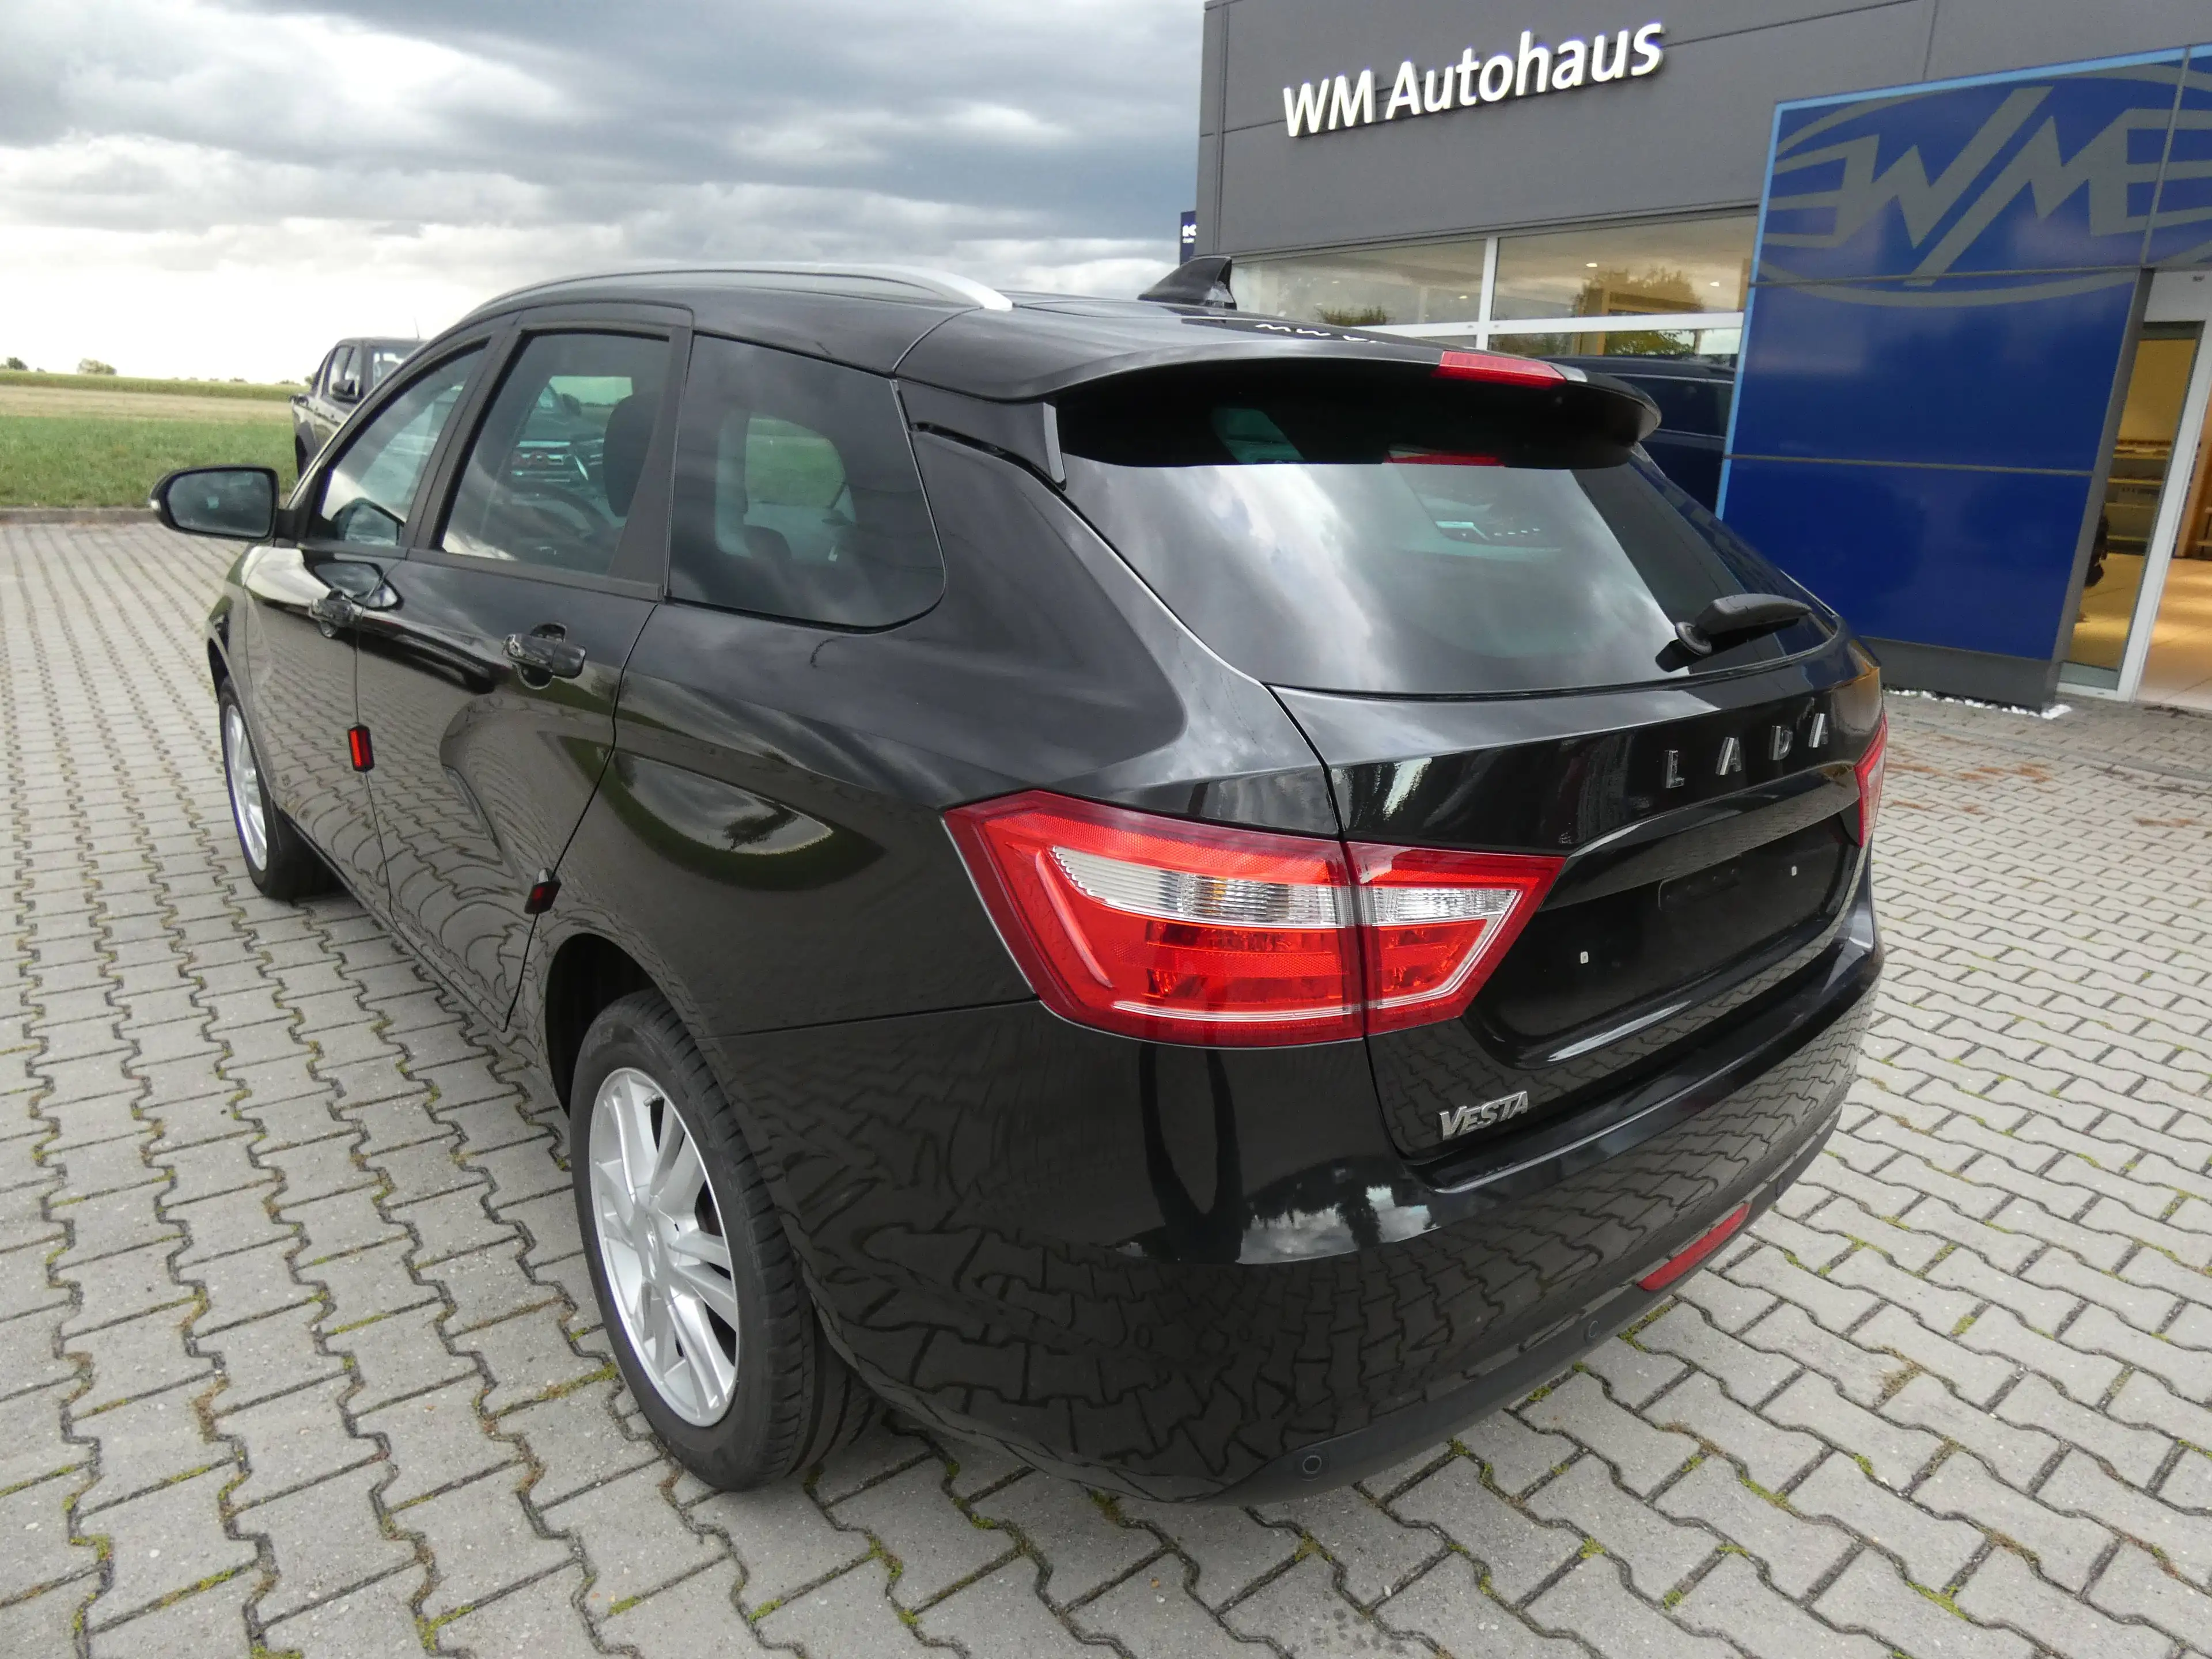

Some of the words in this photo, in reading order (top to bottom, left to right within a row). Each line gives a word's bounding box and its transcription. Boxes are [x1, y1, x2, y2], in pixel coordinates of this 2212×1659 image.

[1283, 69, 1376, 137] WM
[1385, 21, 1664, 120] Autohaus
[1664, 713, 1829, 789] LADA
[1439, 1090, 1528, 1141] VESTA
